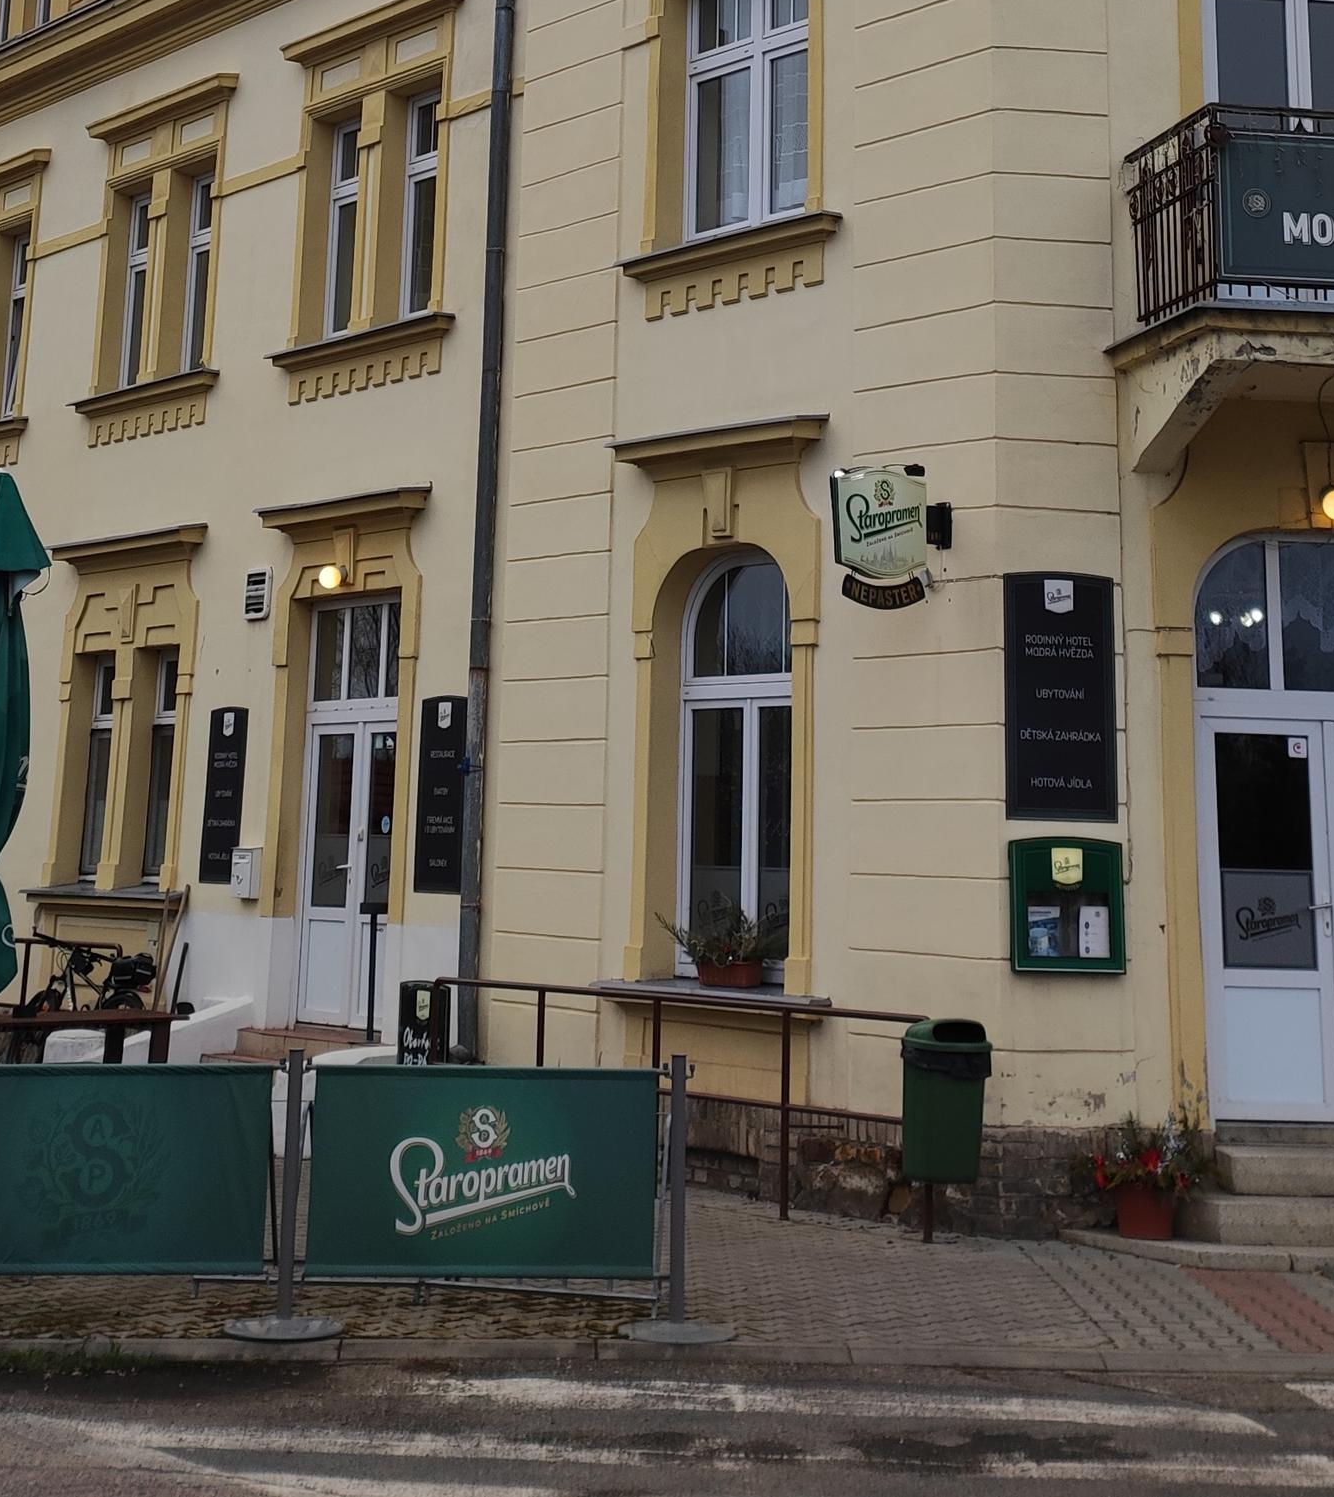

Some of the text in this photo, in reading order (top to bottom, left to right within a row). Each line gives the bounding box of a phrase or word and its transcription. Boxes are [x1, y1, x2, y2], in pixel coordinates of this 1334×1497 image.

[846, 493, 923, 544] Staropramen
[851, 581, 919, 606] NEPASTER
[1025, 633, 1093, 646] RODINNÝ HOTEL
[1025, 645, 1094, 658] MODRÁ HVĚZDA
[1035, 687, 1085, 699] UBYTOVÁNÍ
[1020, 728, 1101, 742] DĚTSKÁ ZAHRÁDKA
[1030, 776, 1093, 789] HOTOVÁ JÍDLA
[390, 1137, 577, 1235] Staropramen
